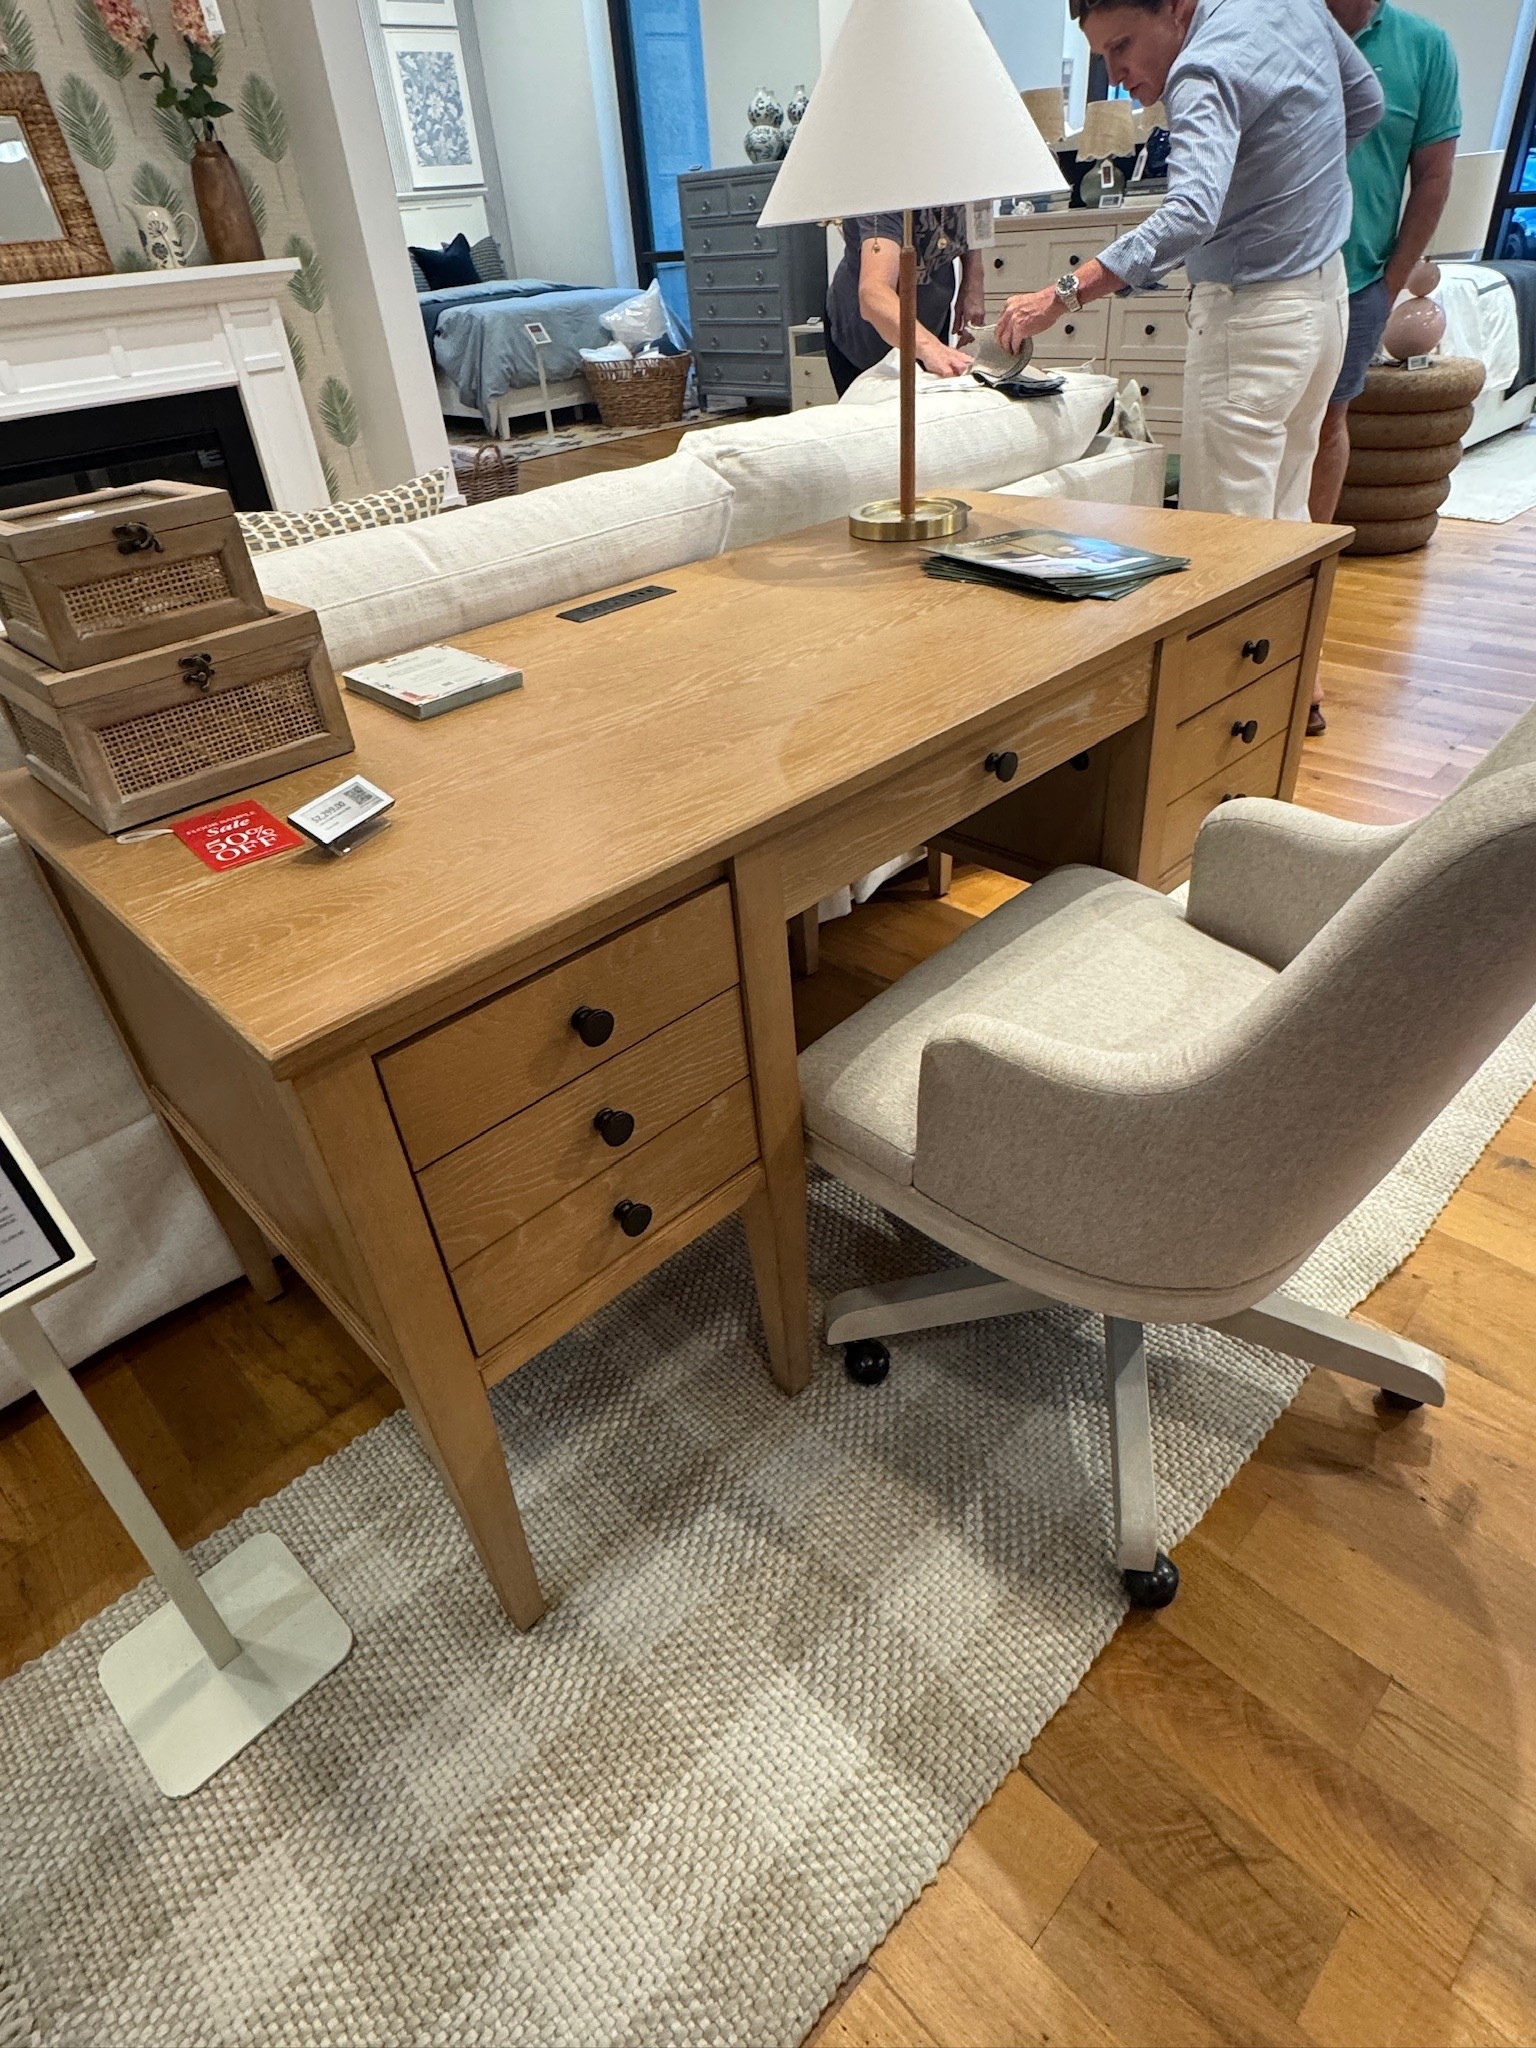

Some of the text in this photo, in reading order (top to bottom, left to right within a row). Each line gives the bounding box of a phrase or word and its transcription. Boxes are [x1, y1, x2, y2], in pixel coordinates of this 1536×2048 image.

[205, 825, 278, 853] 50%
[206, 819, 250, 837] Sale
[216, 837, 277, 861] OFF
